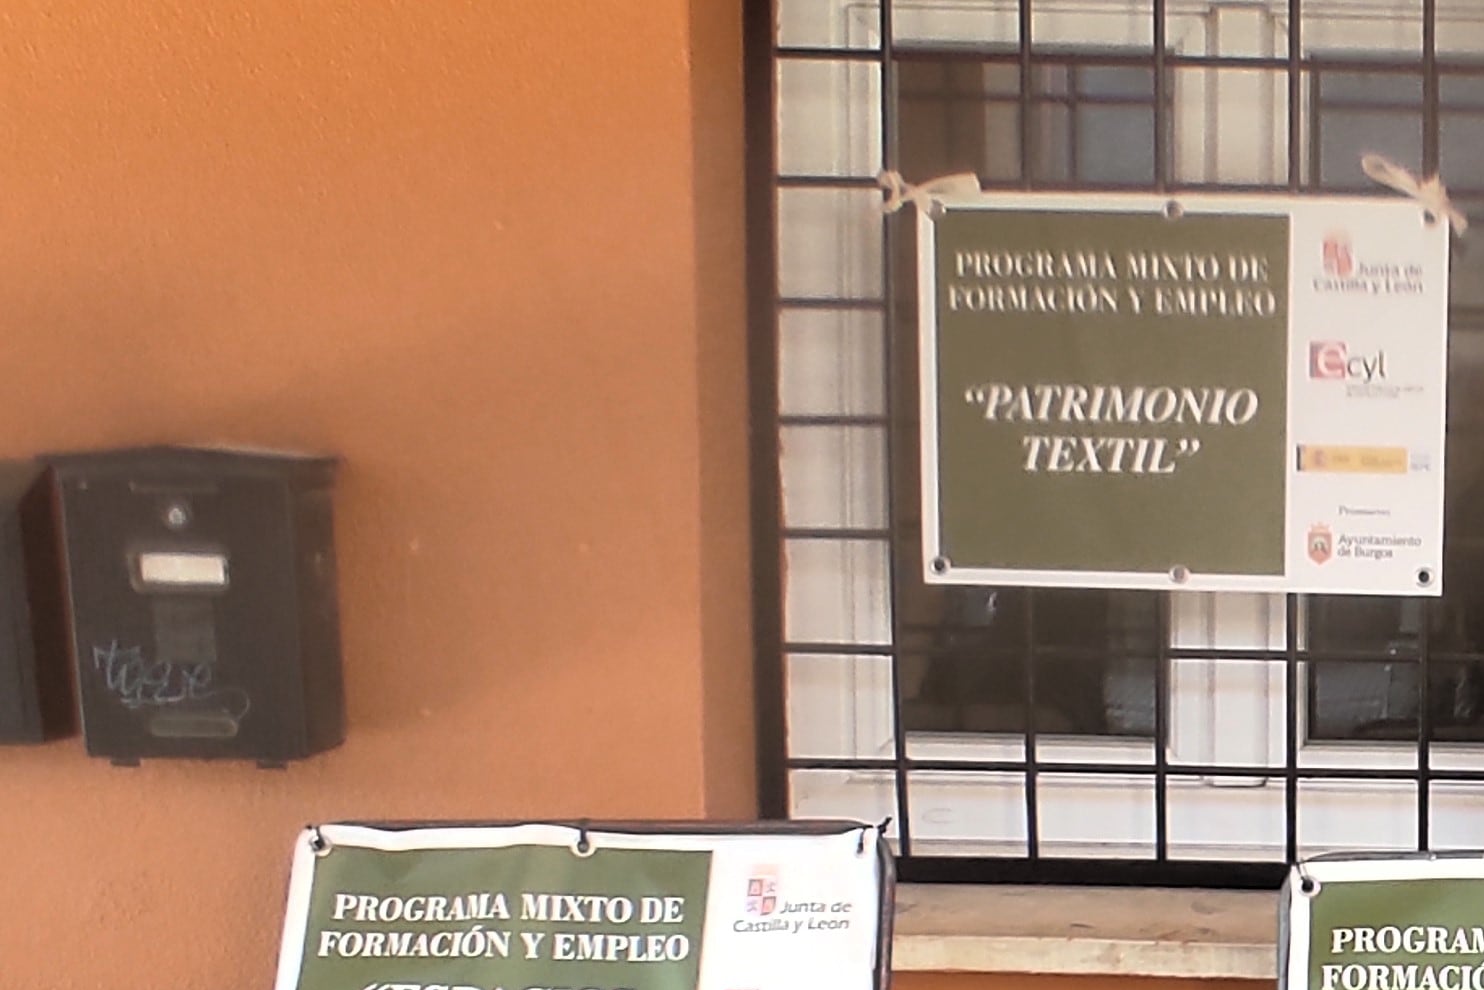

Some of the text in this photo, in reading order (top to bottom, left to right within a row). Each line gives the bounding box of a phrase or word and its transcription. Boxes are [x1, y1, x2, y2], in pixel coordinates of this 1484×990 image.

[957, 253, 1267, 281] PROGRAMA MIXTO DE
[949, 285, 1276, 315] FORMACIÓN Y EMPLEO
[1338, 534, 1422, 547] Ayuntamiento
[1337, 546, 1393, 559] de Burgos
[333, 893, 685, 924] PROGRAMA MIXTO DE
[780, 900, 852, 914] Junta de
[733, 918, 790, 933] Castilla
[792, 920, 803, 934] y
[317, 924, 690, 962] FORMACIÓN Y EMPLEO
